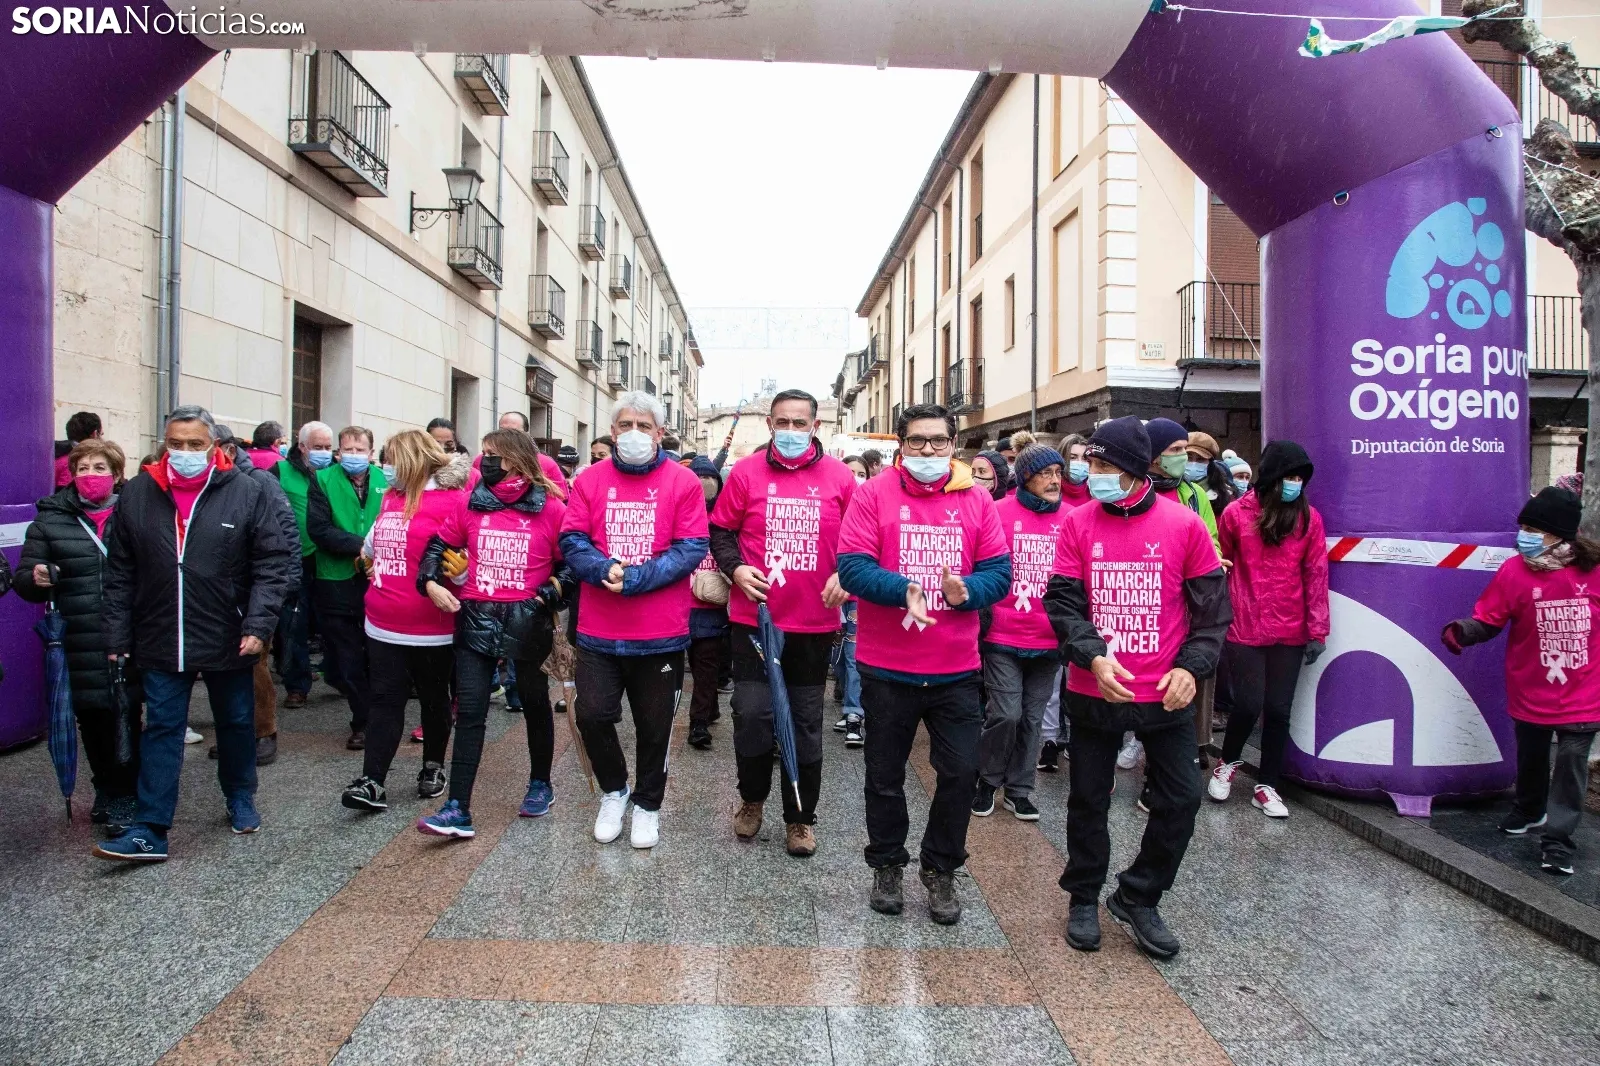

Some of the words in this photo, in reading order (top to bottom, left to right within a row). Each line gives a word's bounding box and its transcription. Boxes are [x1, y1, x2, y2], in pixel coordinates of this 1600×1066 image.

[1351, 333, 1472, 377] Soria
[1350, 379, 1519, 430] Oxígeno
[1351, 437, 1447, 458] Diputación
[1450, 436, 1469, 453] de
[1472, 438, 1505, 453] Soria
[615, 509, 655, 523] MARCHA
[766, 504, 773, 518] II
[776, 505, 820, 520] MARCHA
[606, 523, 655, 536] SOLIDARIA
[766, 518, 819, 533] SOLIDARIA
[478, 536, 483, 549] II
[485, 536, 529, 553] MARCHA
[642, 542, 653, 555] EL
[765, 538, 804, 552] CONTRA
[806, 541, 818, 553] EL
[900, 533, 907, 549] II
[911, 533, 962, 551] MARCHA
[1022, 540, 1055, 554] MARCH
[396, 548, 406, 560] EL
[477, 550, 527, 565] SOLIDARIA
[899, 550, 962, 566] SOLIDARIA
[476, 564, 511, 580] CONTRA
[514, 570, 525, 581] EL
[1013, 569, 1048, 582] CONTRA
[1092, 571, 1099, 589] II
[1104, 572, 1162, 589] MARCHA
[1092, 589, 1161, 605] SOLIDARIA
[1092, 605, 1099, 613] EL
[1100, 605, 1120, 614] BURGO
[1131, 607, 1149, 615] OSMA
[1545, 605, 1591, 620] MARCHA
[1092, 613, 1142, 630] CONTRA
[1146, 615, 1160, 631] EL
[1537, 619, 1591, 632] SOLIDARIA
[1540, 638, 1580, 651] CONTRA
[1581, 637, 1588, 650] EL
